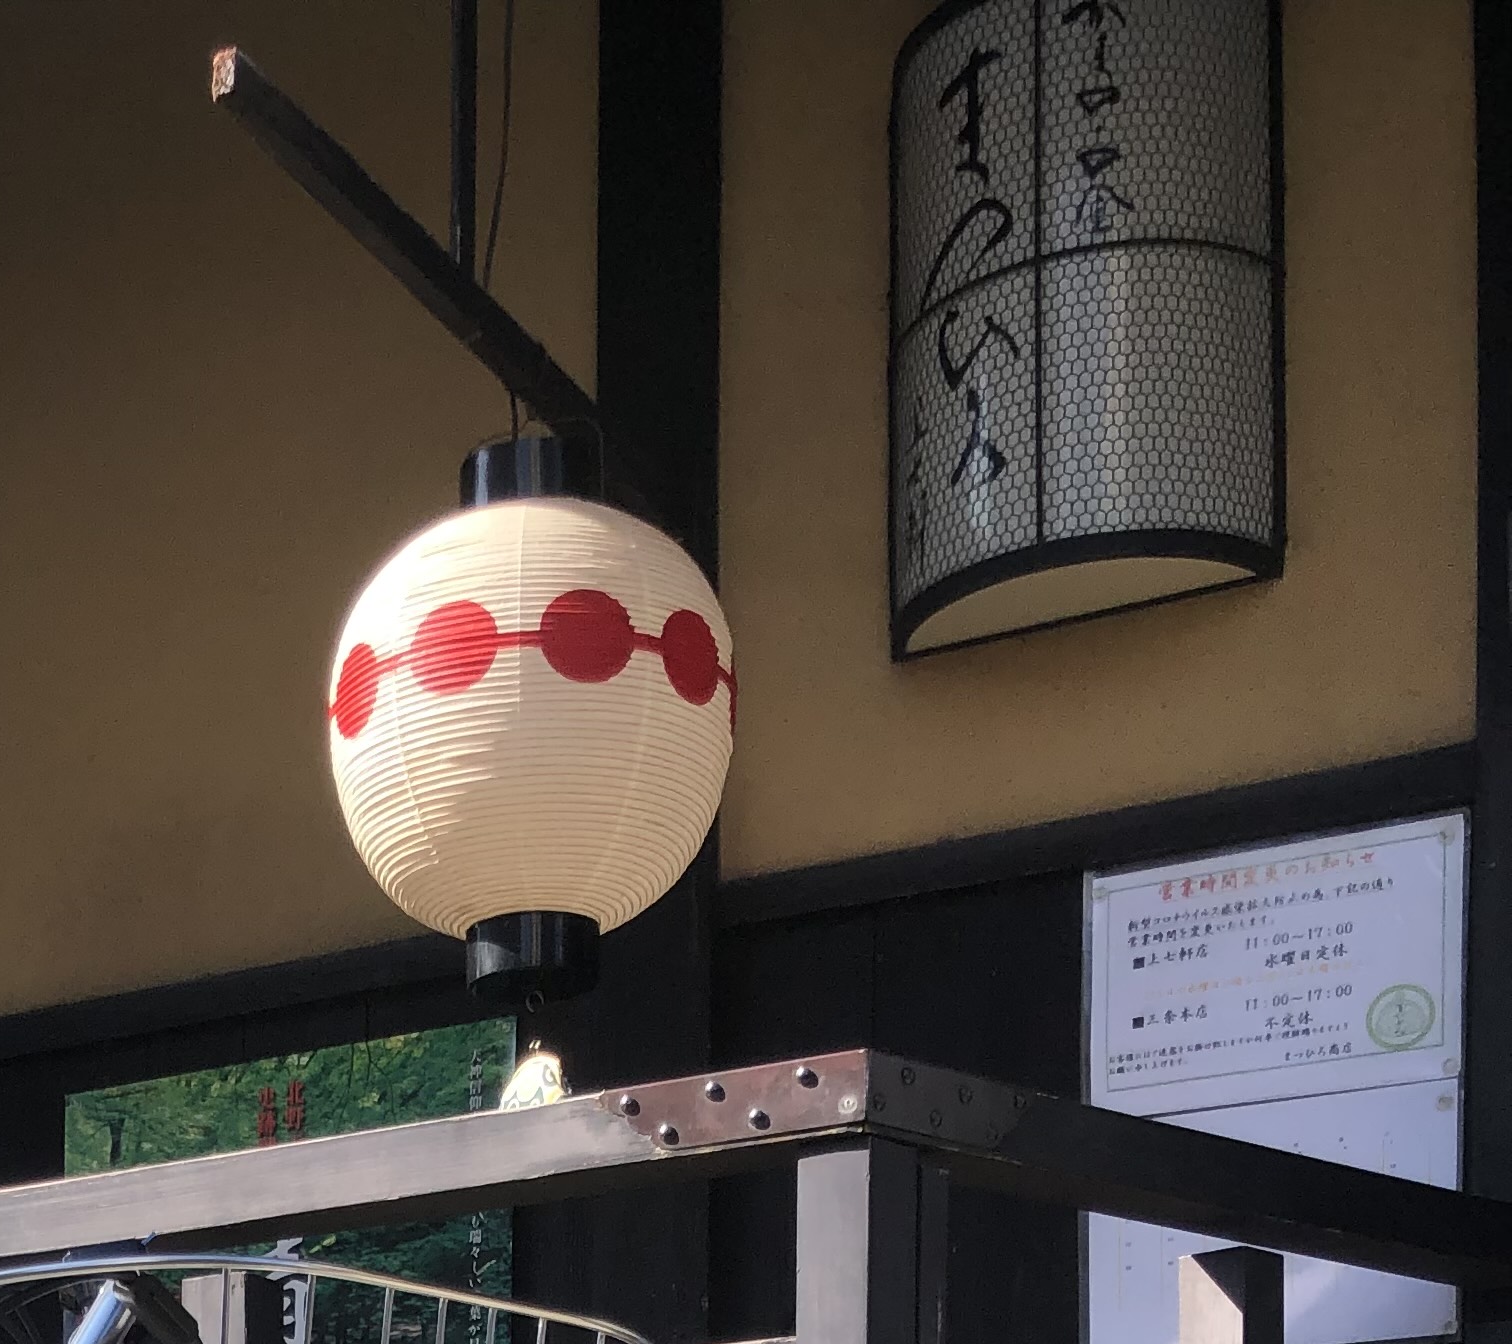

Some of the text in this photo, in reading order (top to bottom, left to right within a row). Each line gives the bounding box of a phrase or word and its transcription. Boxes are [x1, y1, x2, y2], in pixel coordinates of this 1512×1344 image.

[1147, 943, 1209, 966] 上七軒店
[1264, 943, 1348, 968] 水曜日定休
[1146, 1004, 1209, 1026] 三条本店
[1264, 1010, 1314, 1030] 不定休
[1284, 1041, 1353, 1062] まつひろ商店
[285, 1079, 304, 1141] 北野
